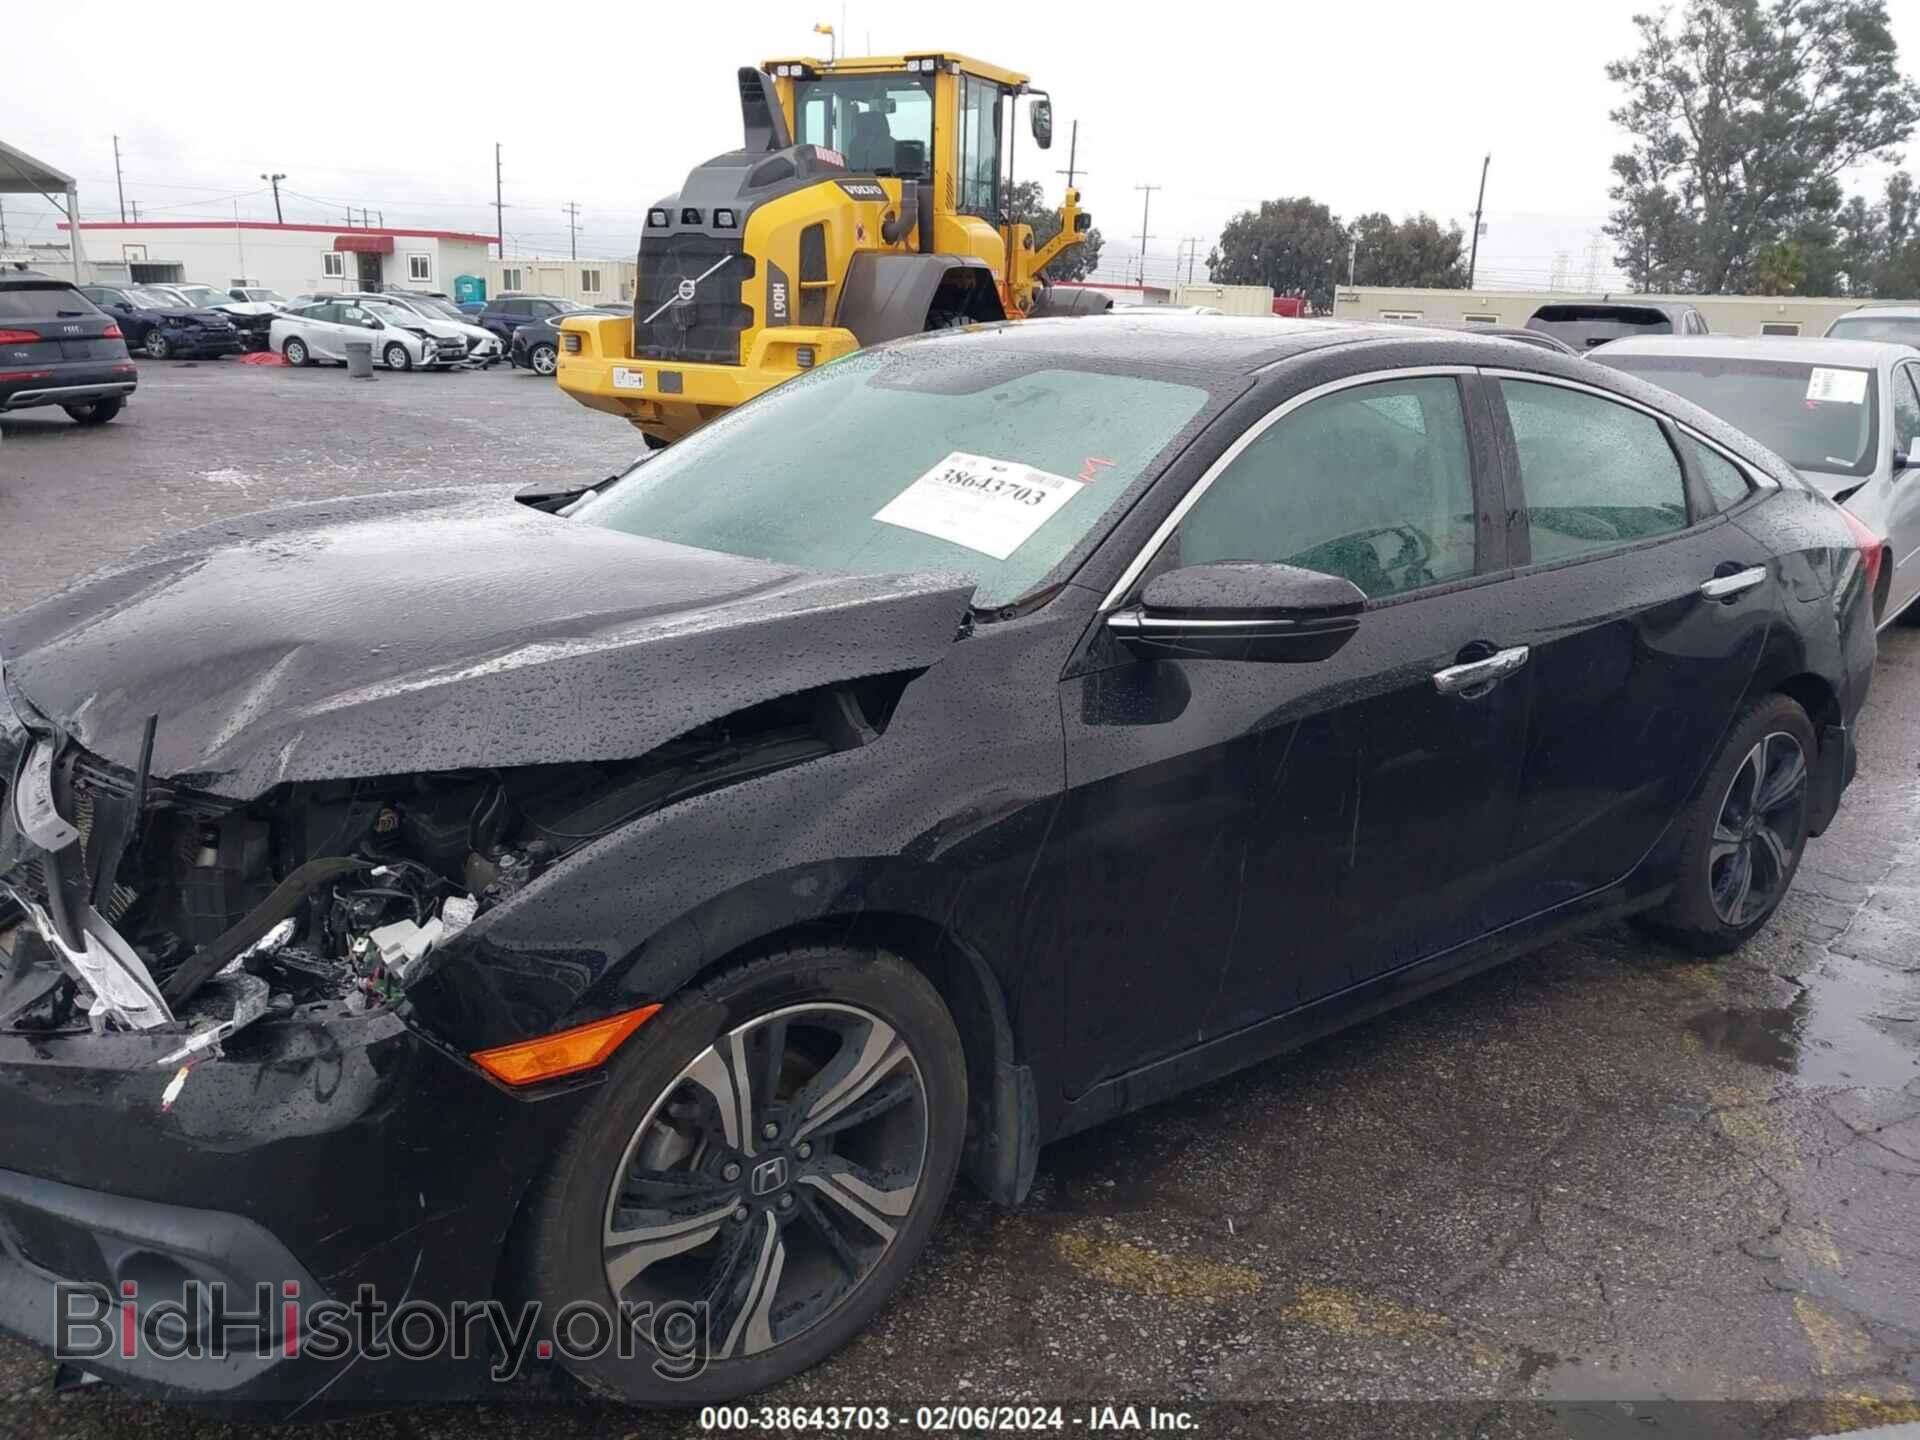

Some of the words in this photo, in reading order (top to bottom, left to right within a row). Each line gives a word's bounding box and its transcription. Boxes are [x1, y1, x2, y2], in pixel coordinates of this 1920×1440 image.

[843, 185, 883, 195] VOLVO
[772, 283, 787, 318] L90H
[935, 467, 1047, 506] 38643703
